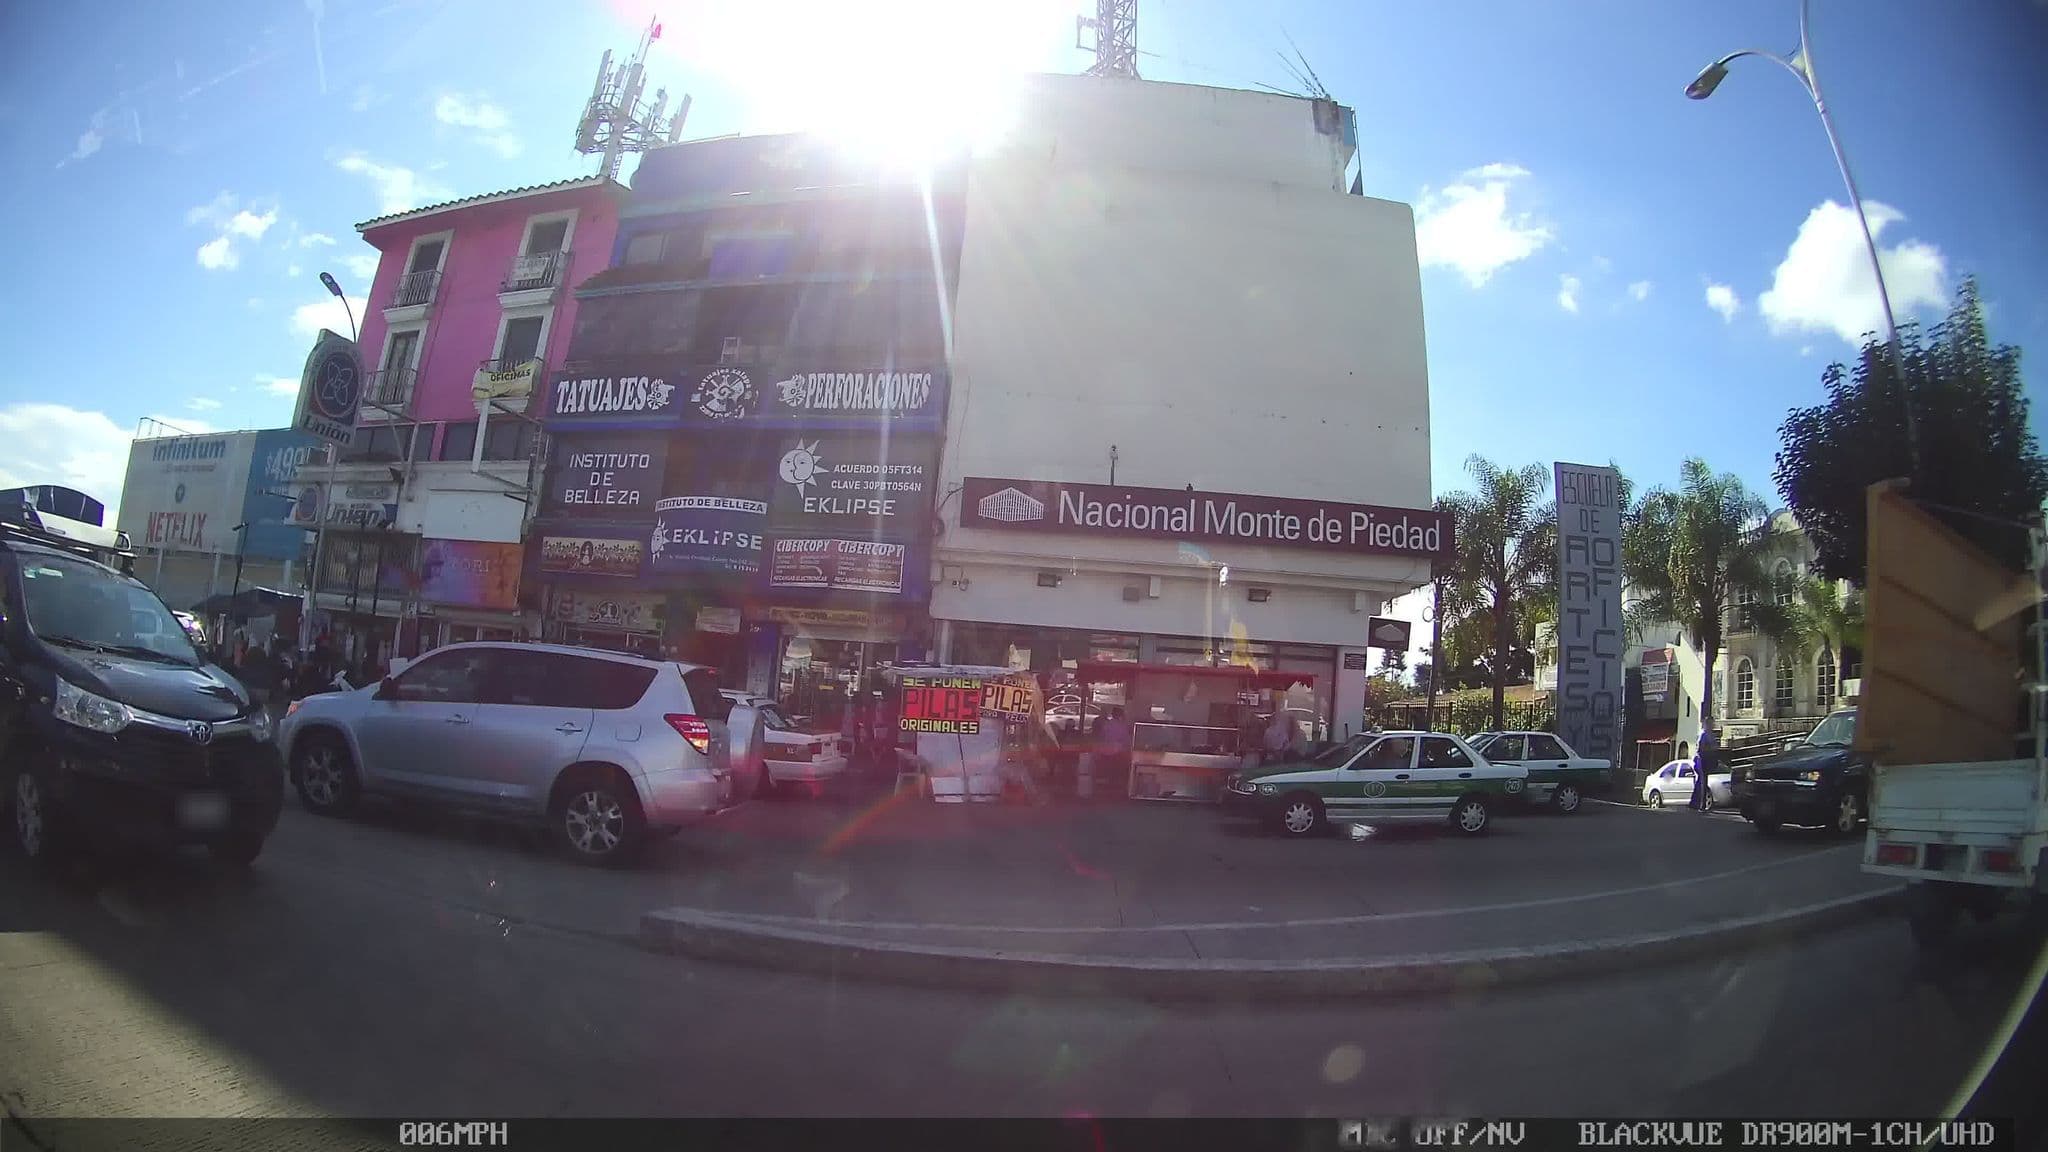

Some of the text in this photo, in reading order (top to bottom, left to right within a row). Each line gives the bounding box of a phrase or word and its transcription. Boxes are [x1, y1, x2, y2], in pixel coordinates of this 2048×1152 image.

[490, 369, 531, 382] OFICINAS
[556, 376, 649, 413] TATUAJES
[804, 372, 931, 410] PERFORACIONES
[153, 439, 226, 461] infinitum
[569, 453, 650, 468] INSTITUTO
[834, 464, 923, 475] ACUERDO 05FT314
[590, 472, 614, 486] DE
[831, 480, 860, 490] CLAVE
[564, 489, 640, 505] BELLEZA
[1562, 471, 1613, 508] ESCUELA
[697, 498, 711, 507] DE
[714, 499, 763, 513] BELLEZA
[804, 497, 896, 516] EKLIPSE
[1058, 490, 1440, 551] Nacional Monte de Piedad
[1580, 509, 1600, 534] DE
[146, 512, 207, 548] NETFLIX
[672, 529, 763, 551] EKLIPSE
[776, 540, 830, 552] CIBERCOPY
[838, 541, 903, 557] CIBERCOPY
[932, 677, 980, 689] PONEN
[903, 689, 979, 718] PILAS
[981, 686, 1033, 713] PILAS
[900, 718, 978, 733] ORIGINALES
